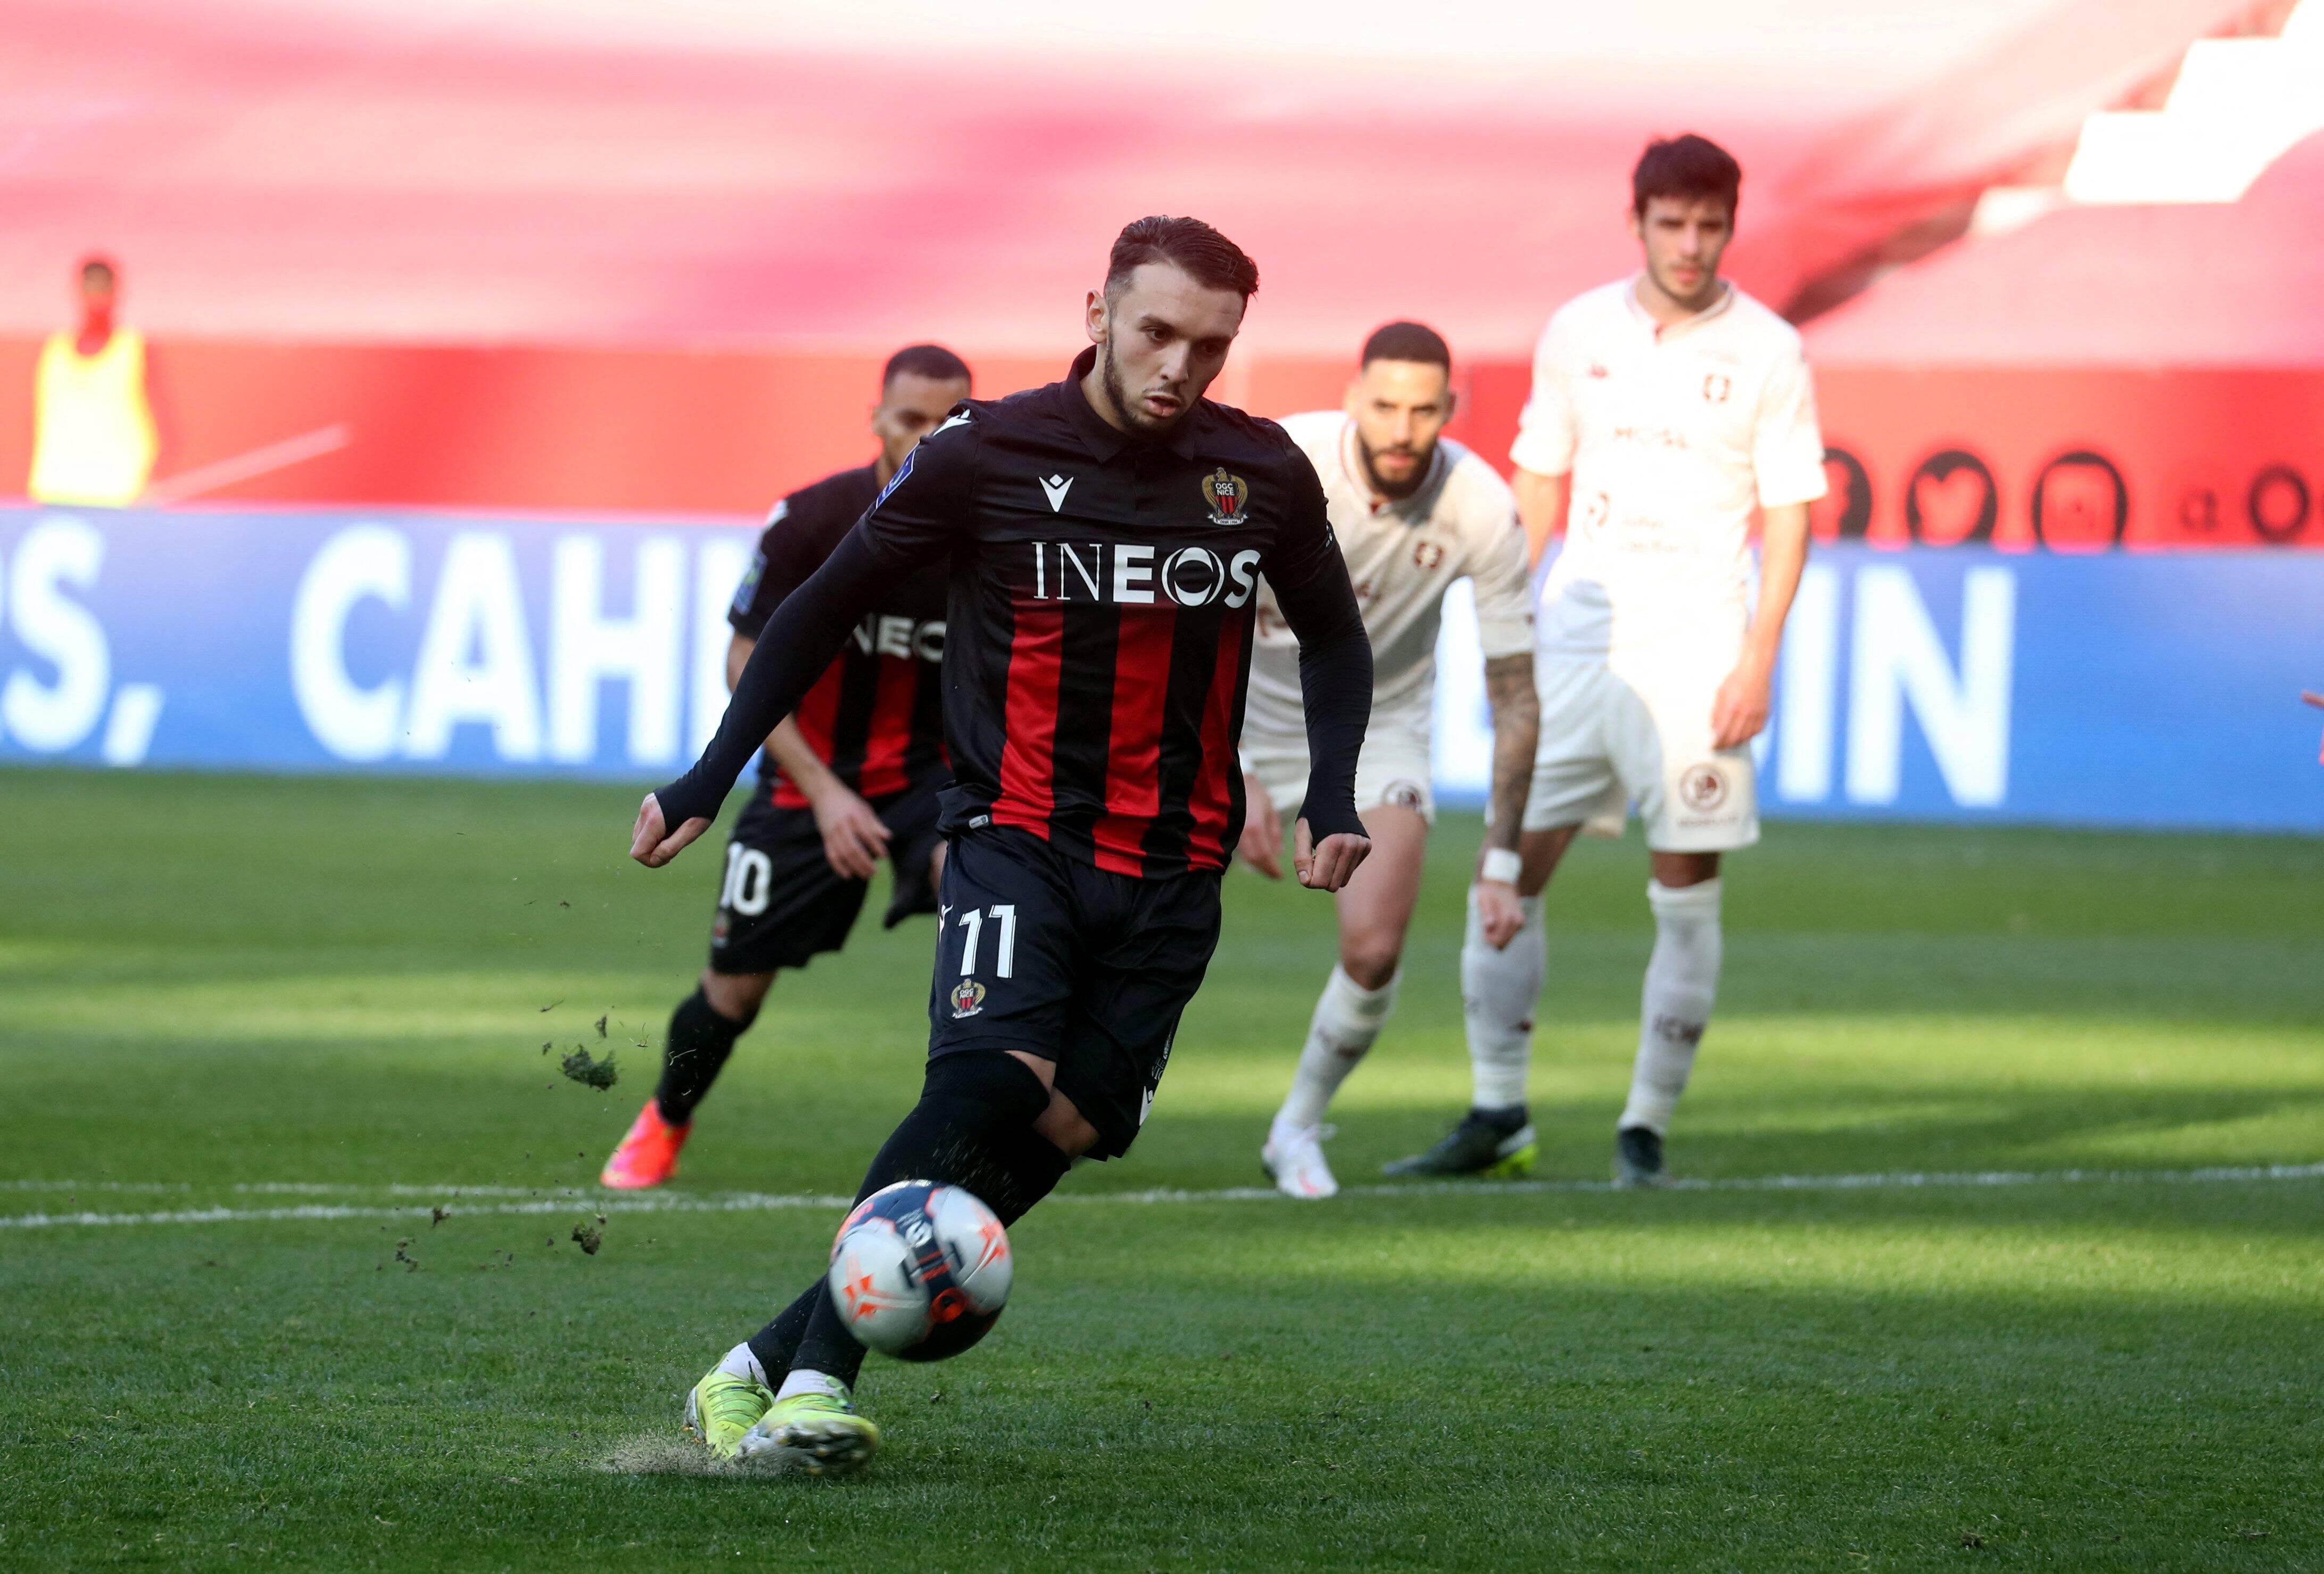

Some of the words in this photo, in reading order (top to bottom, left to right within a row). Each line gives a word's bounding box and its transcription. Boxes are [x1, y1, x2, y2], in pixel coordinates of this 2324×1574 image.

[1031, 541, 1261, 609] INEOS
[0, 514, 166, 768] S,
[851, 612, 947, 663] NEO
[1753, 562, 2017, 806] IN
[720, 840, 772, 917] 10
[958, 904, 1016, 978] 11
